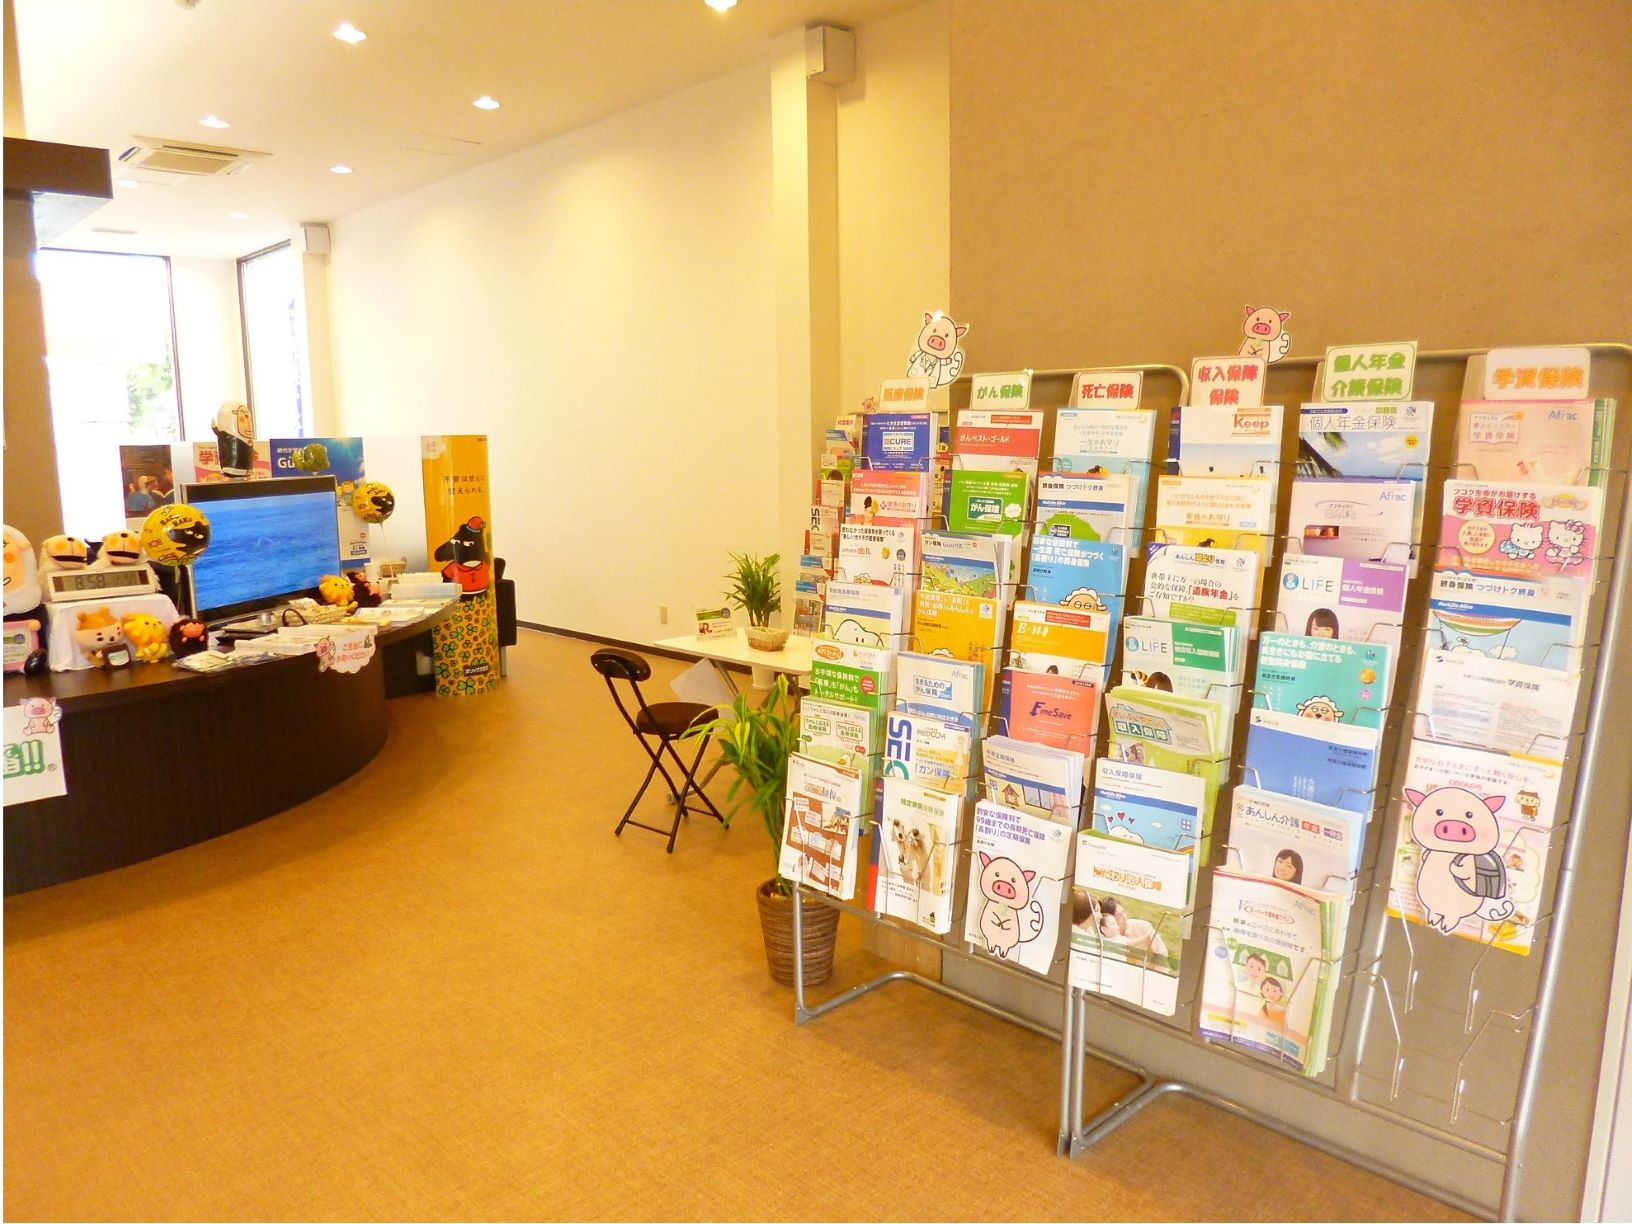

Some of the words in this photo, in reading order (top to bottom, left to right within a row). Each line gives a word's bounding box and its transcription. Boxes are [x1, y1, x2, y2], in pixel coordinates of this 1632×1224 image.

[1333, 352, 1406, 372] 個人年金
[1198, 365, 1259, 382] 収入保障
[1493, 367, 1585, 389] 学資保険
[884, 388, 925, 401] 医療保険
[976, 384, 1024, 399] がん保険
[1081, 384, 1134, 399] 死亡保険
[1331, 377, 1404, 397] 介護保険
[1209, 389, 1239, 405] 保険
[1233, 414, 1270, 429] Keep
[1309, 415, 1398, 430] 個人年金保険
[1549, 410, 1578, 421] Aflac
[890, 438, 912, 447] CURE
[960, 435, 1010, 443] がんベスト・ゴールド
[1473, 431, 1516, 440] 学資保険
[1379, 491, 1406, 502] Aflac
[1453, 488, 1537, 500] フコク生命がお届けする
[970, 503, 1000, 513] がん保険
[1452, 497, 1541, 521] 学資保険
[1186, 513, 1231, 522] 家族のお守り
[1150, 572, 1222, 588] 世帯主に万一の場合の
[1440, 580, 1474, 590] 終身保険
[1477, 584, 1536, 597] つづけトク終身
[815, 668, 860, 683] お手頃な保険料で
[915, 676, 945, 690] 生きるための
[915, 685, 938, 696] がん保険
[1507, 678, 1541, 691] 学資保険
[1115, 721, 1168, 741] 収入保障
[976, 807, 1021, 824] 割安な保険料で
[1245, 803, 1300, 829] あんしん介護
